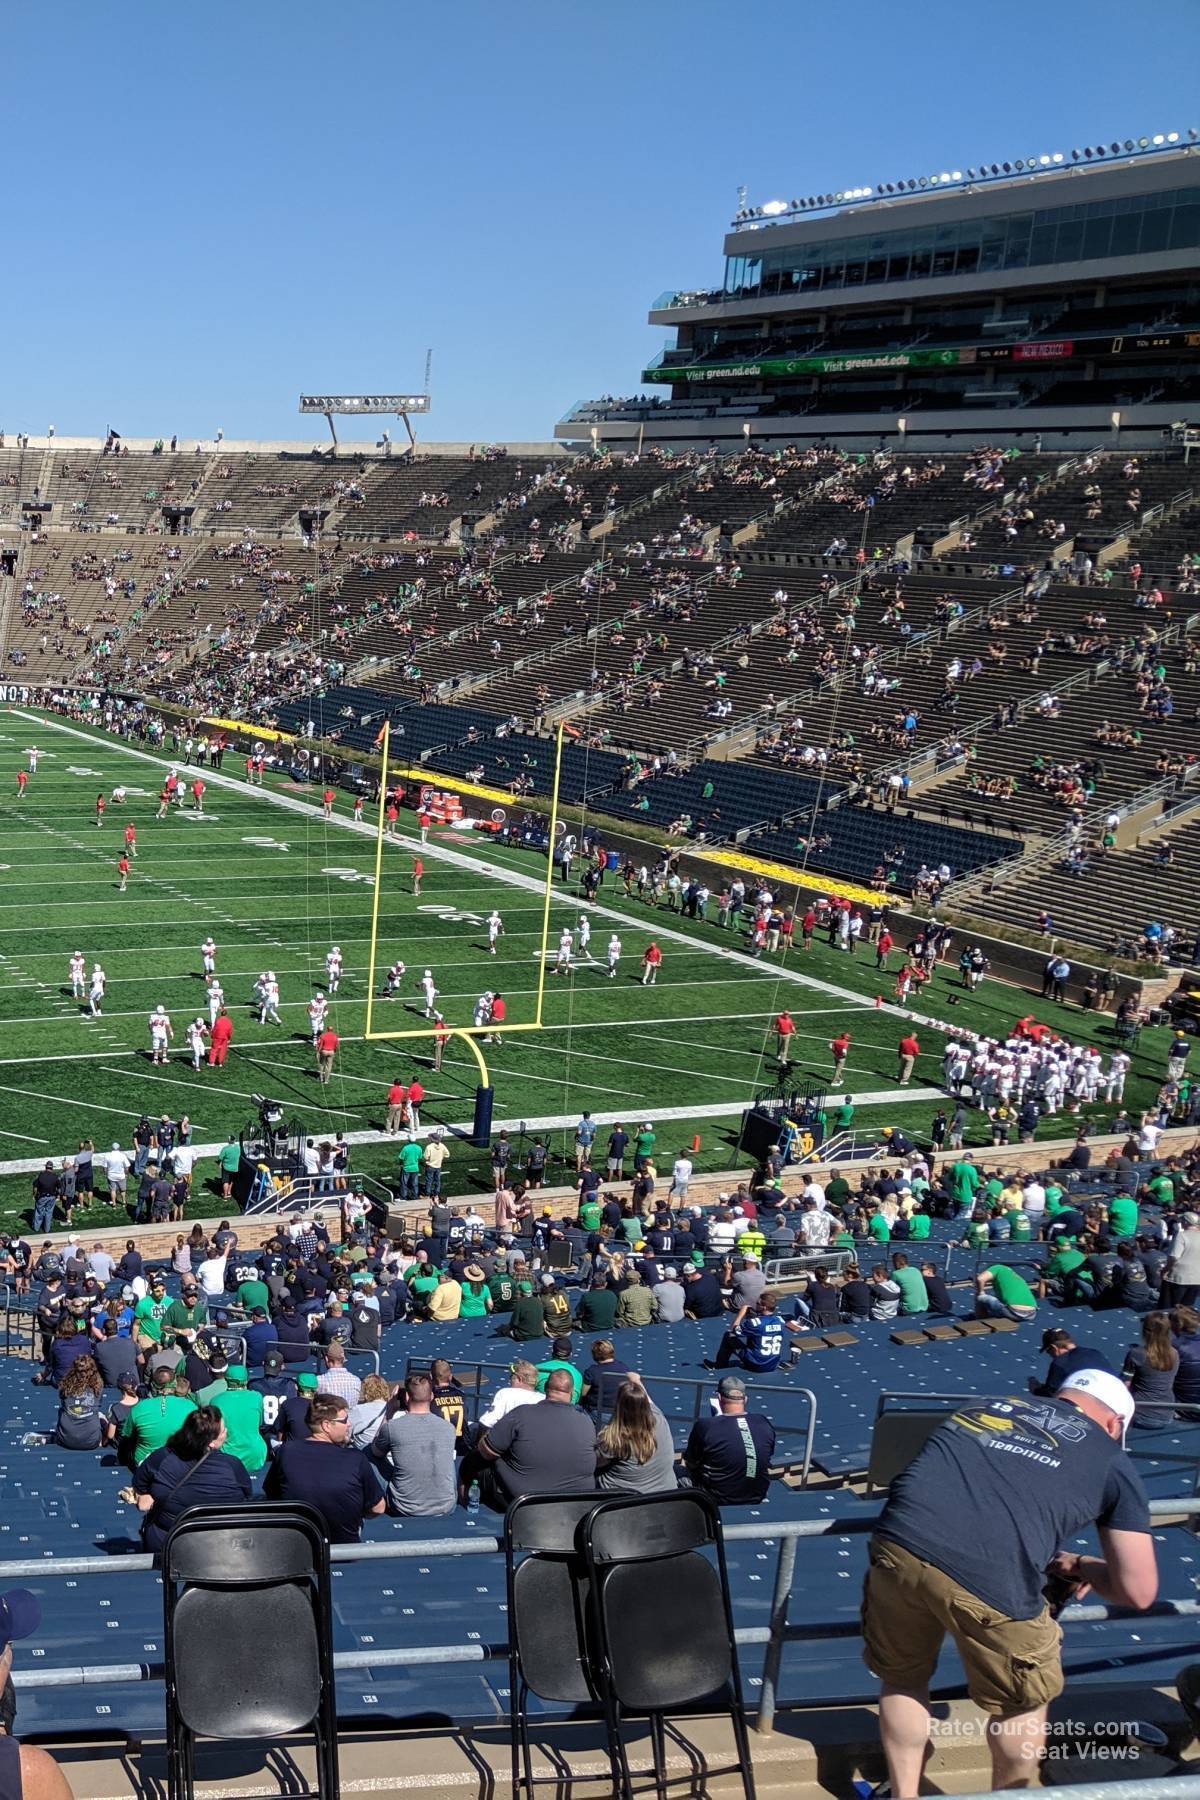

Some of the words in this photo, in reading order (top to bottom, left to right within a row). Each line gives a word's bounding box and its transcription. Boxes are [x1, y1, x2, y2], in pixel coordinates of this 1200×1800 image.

[1022, 346, 1038, 357] NEW
[1040, 344, 1064, 355] MEXICO
[823, 361, 843, 372] Visit
[844, 354, 910, 371] green.nd.edu
[686, 370, 705, 381] Visit
[706, 365, 761, 380] green.nd.edu
[501, 1282, 512, 1300] 5
[551, 1294, 569, 1314] 14
[761, 1335, 782, 1356] 56
[991, 1402, 1013, 1413] 19
[441, 1406, 464, 1437] 17
[1013, 1435, 1037, 1445] BUILT
[989, 1439, 1061, 1468] TRADITION
